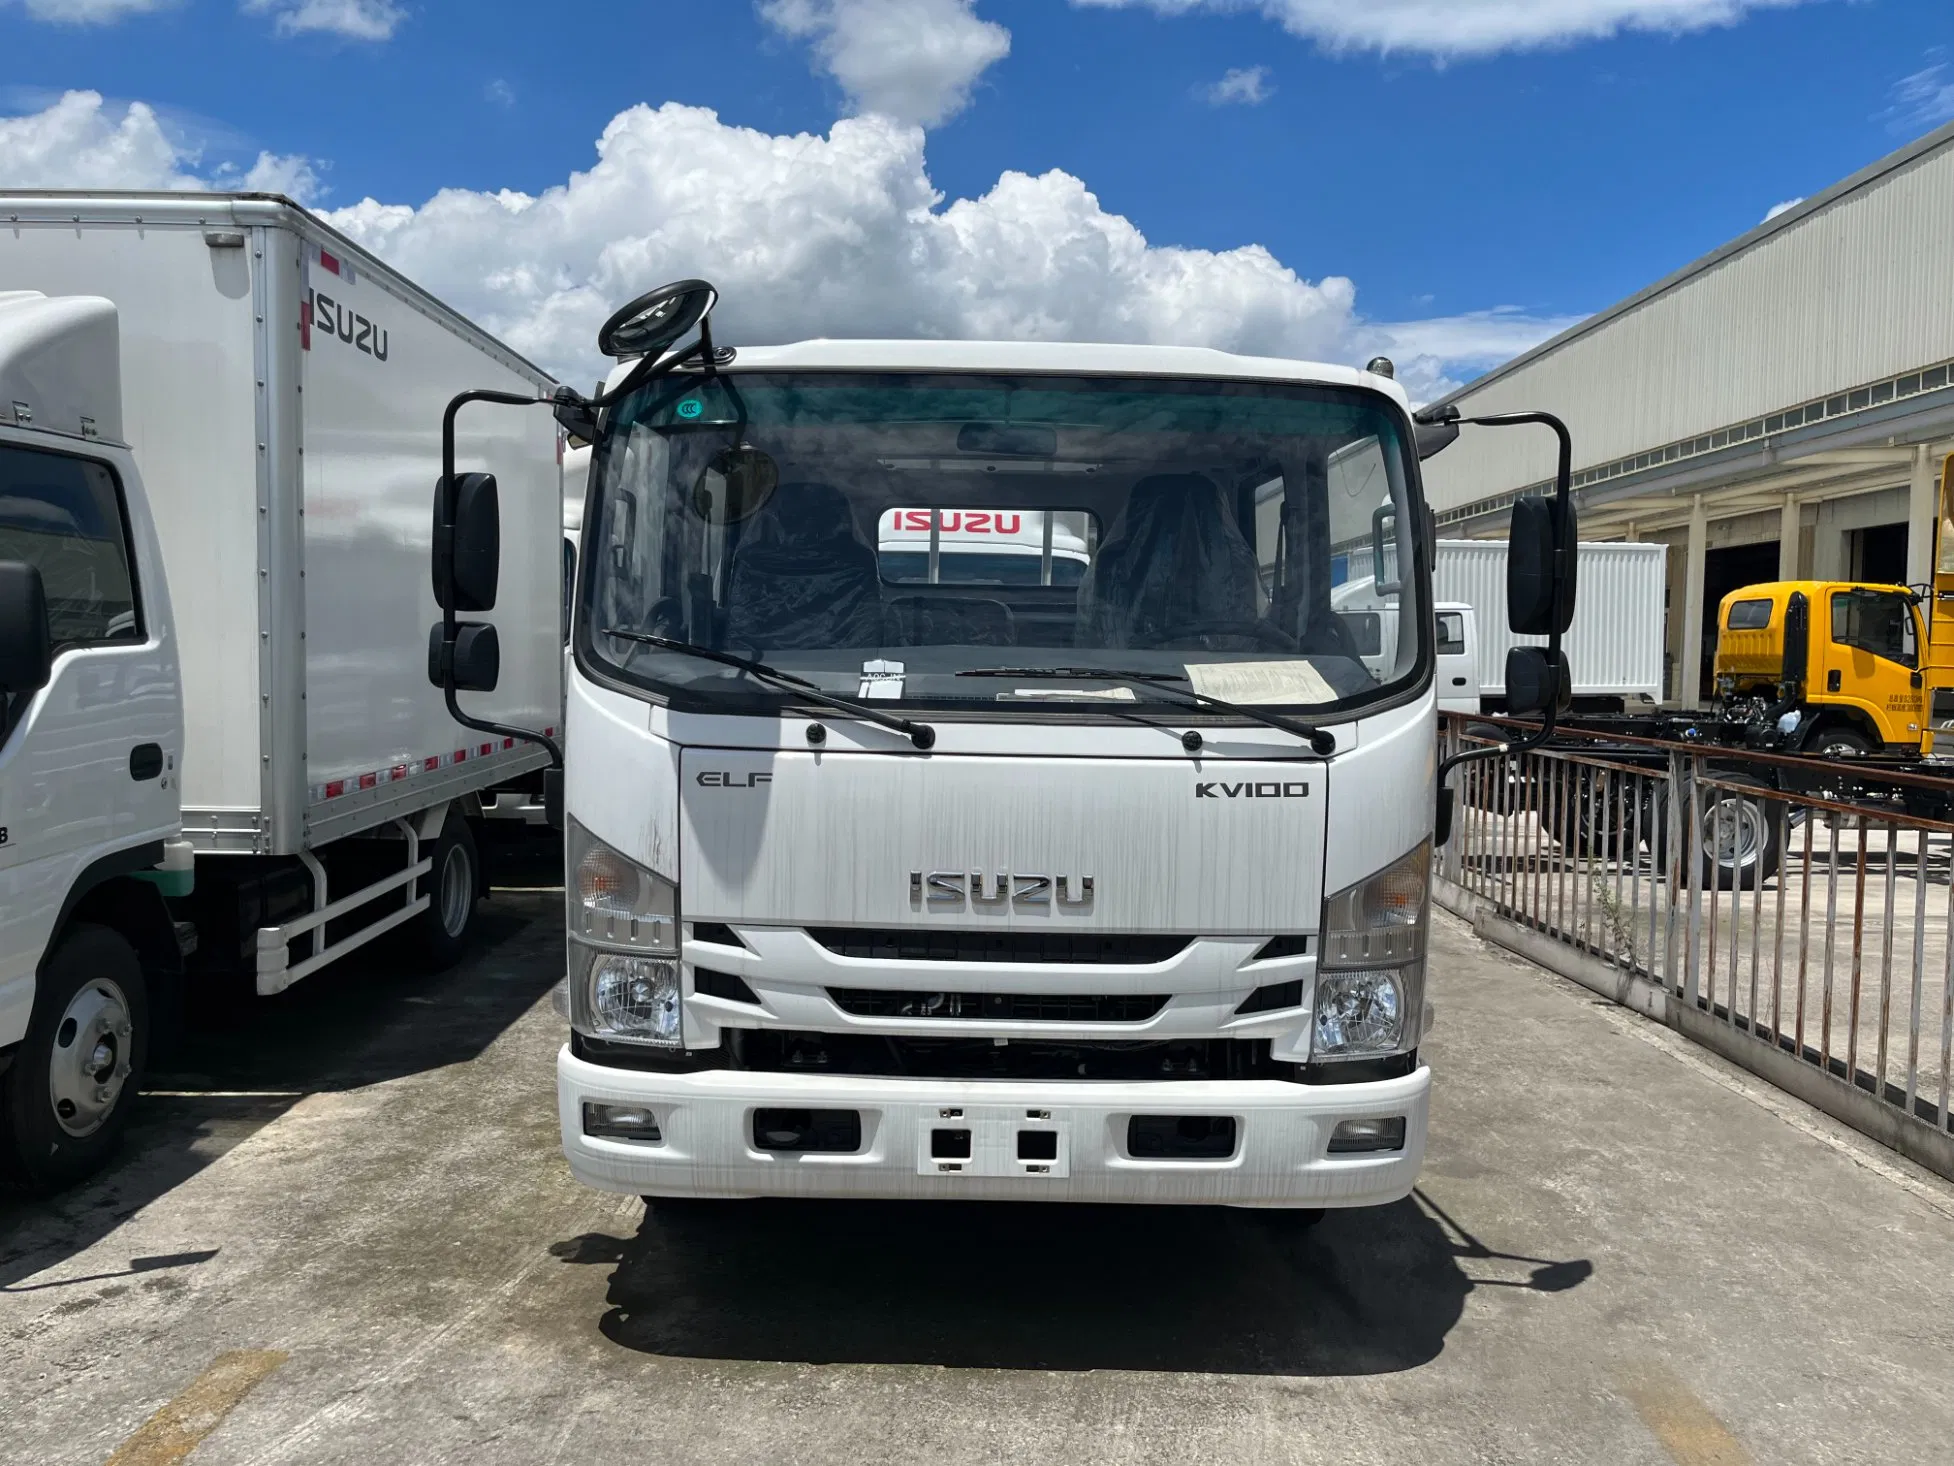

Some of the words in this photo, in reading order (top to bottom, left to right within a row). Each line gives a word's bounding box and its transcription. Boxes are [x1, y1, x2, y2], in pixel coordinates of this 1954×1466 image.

[309, 286, 388, 362] ISUZU
[893, 510, 1021, 534] ISUZU
[696, 771, 774, 788] ELF
[1195, 782, 1310, 798] KV100
[909, 870, 1095, 910] ISUZU
